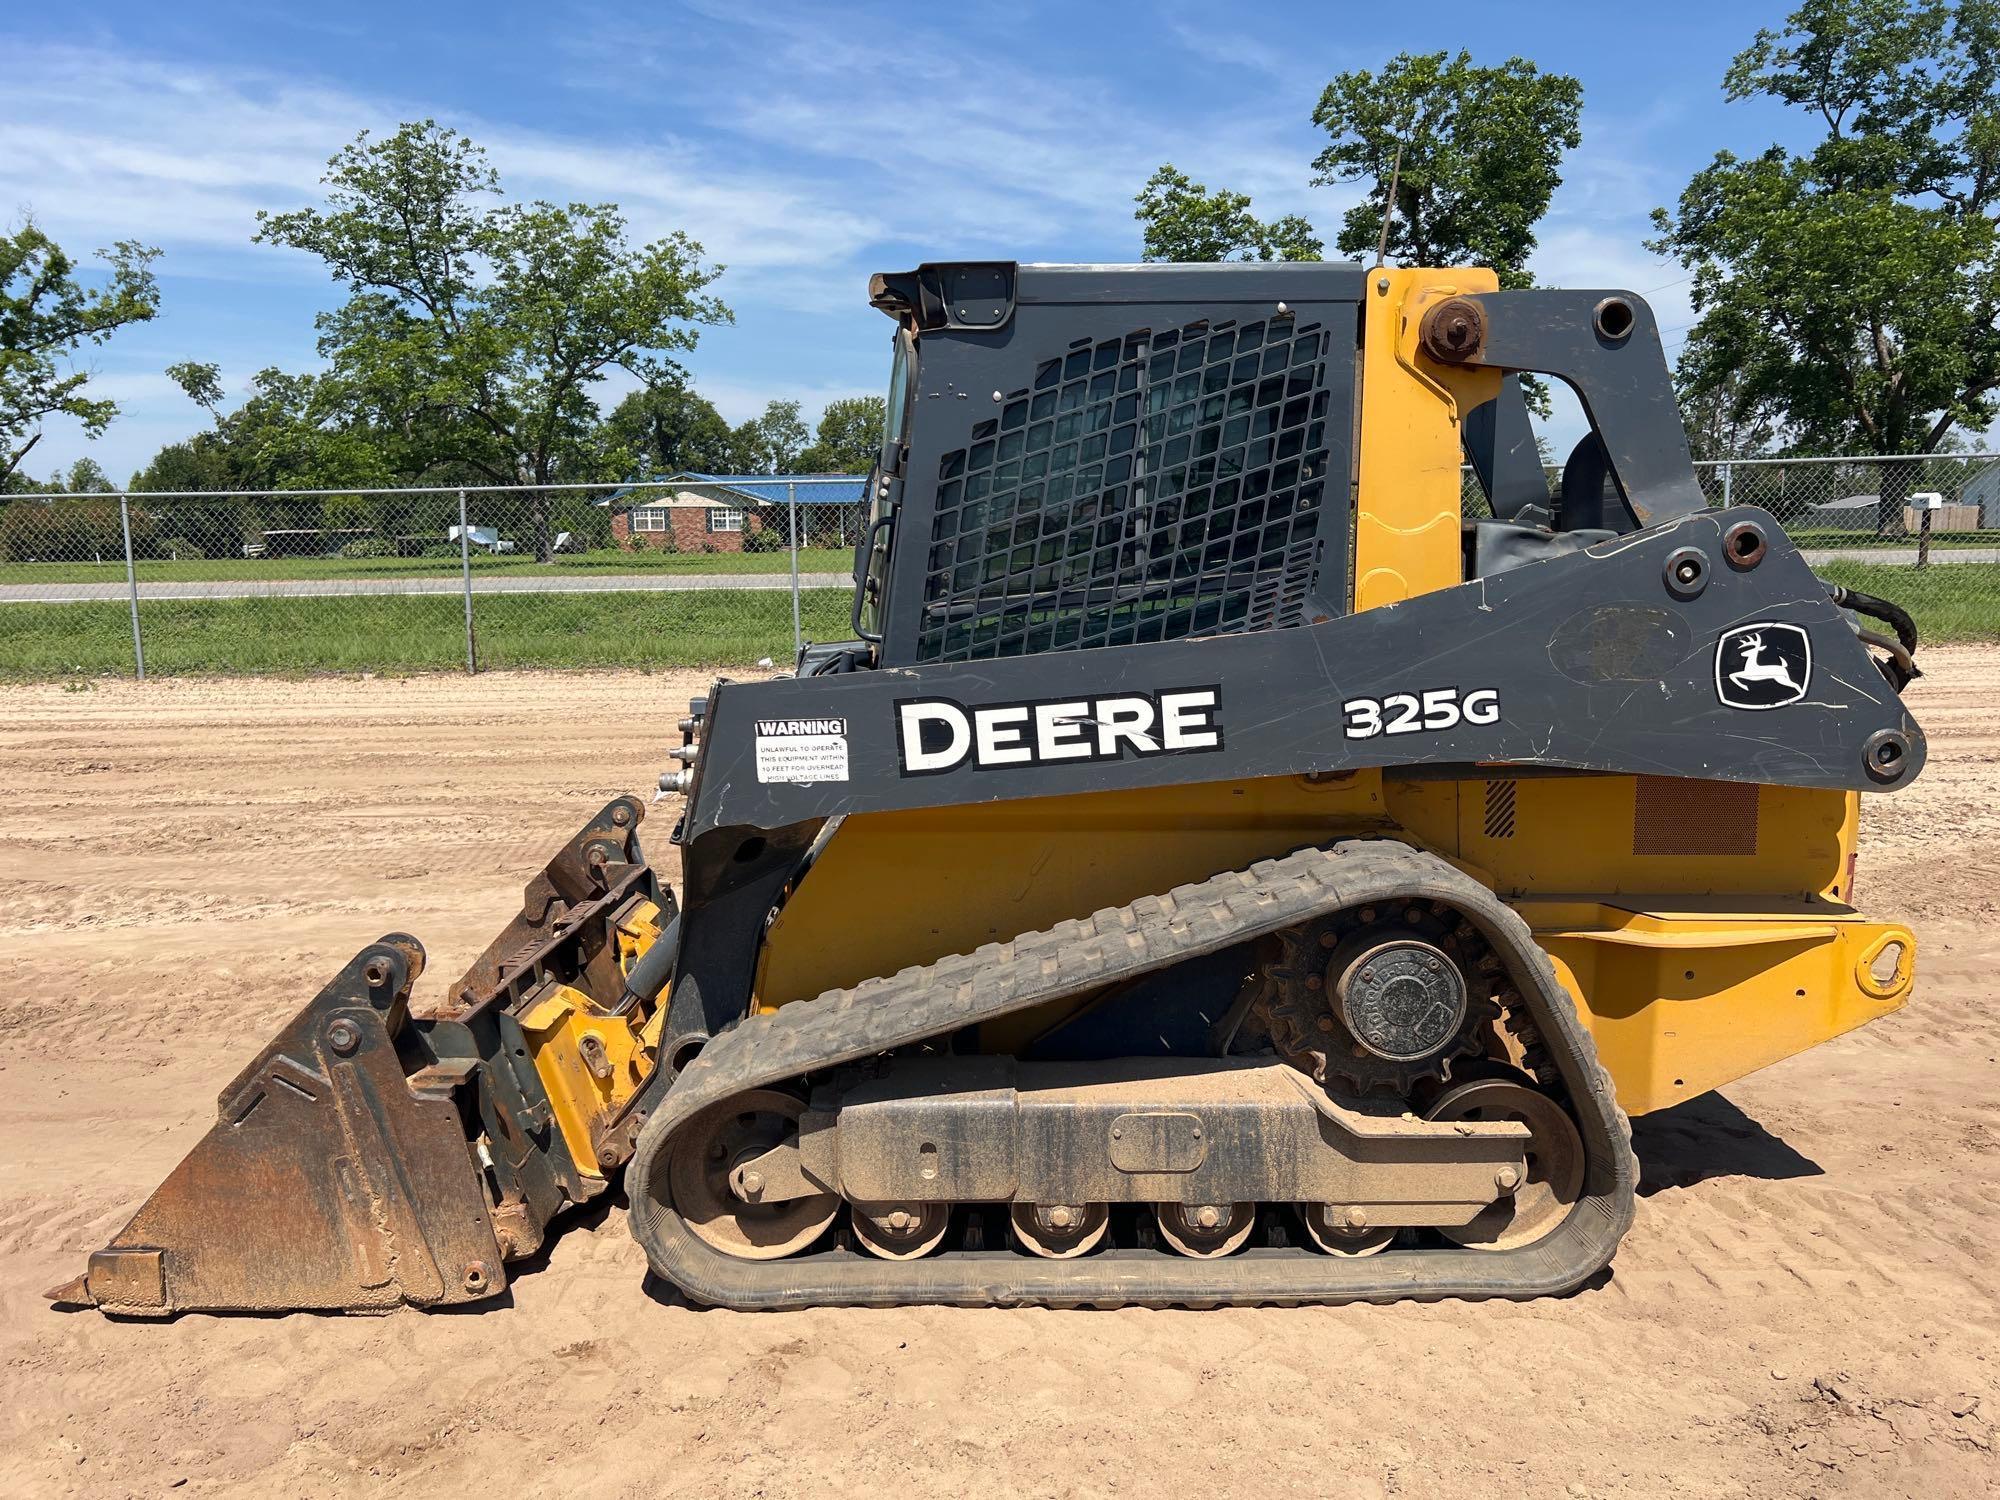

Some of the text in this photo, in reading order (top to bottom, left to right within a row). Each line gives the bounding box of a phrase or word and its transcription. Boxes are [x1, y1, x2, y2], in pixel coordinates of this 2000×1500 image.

[760, 720, 842, 736] WARNING
[901, 691, 1218, 771] DEERE
[1344, 689, 1499, 738] 325G
